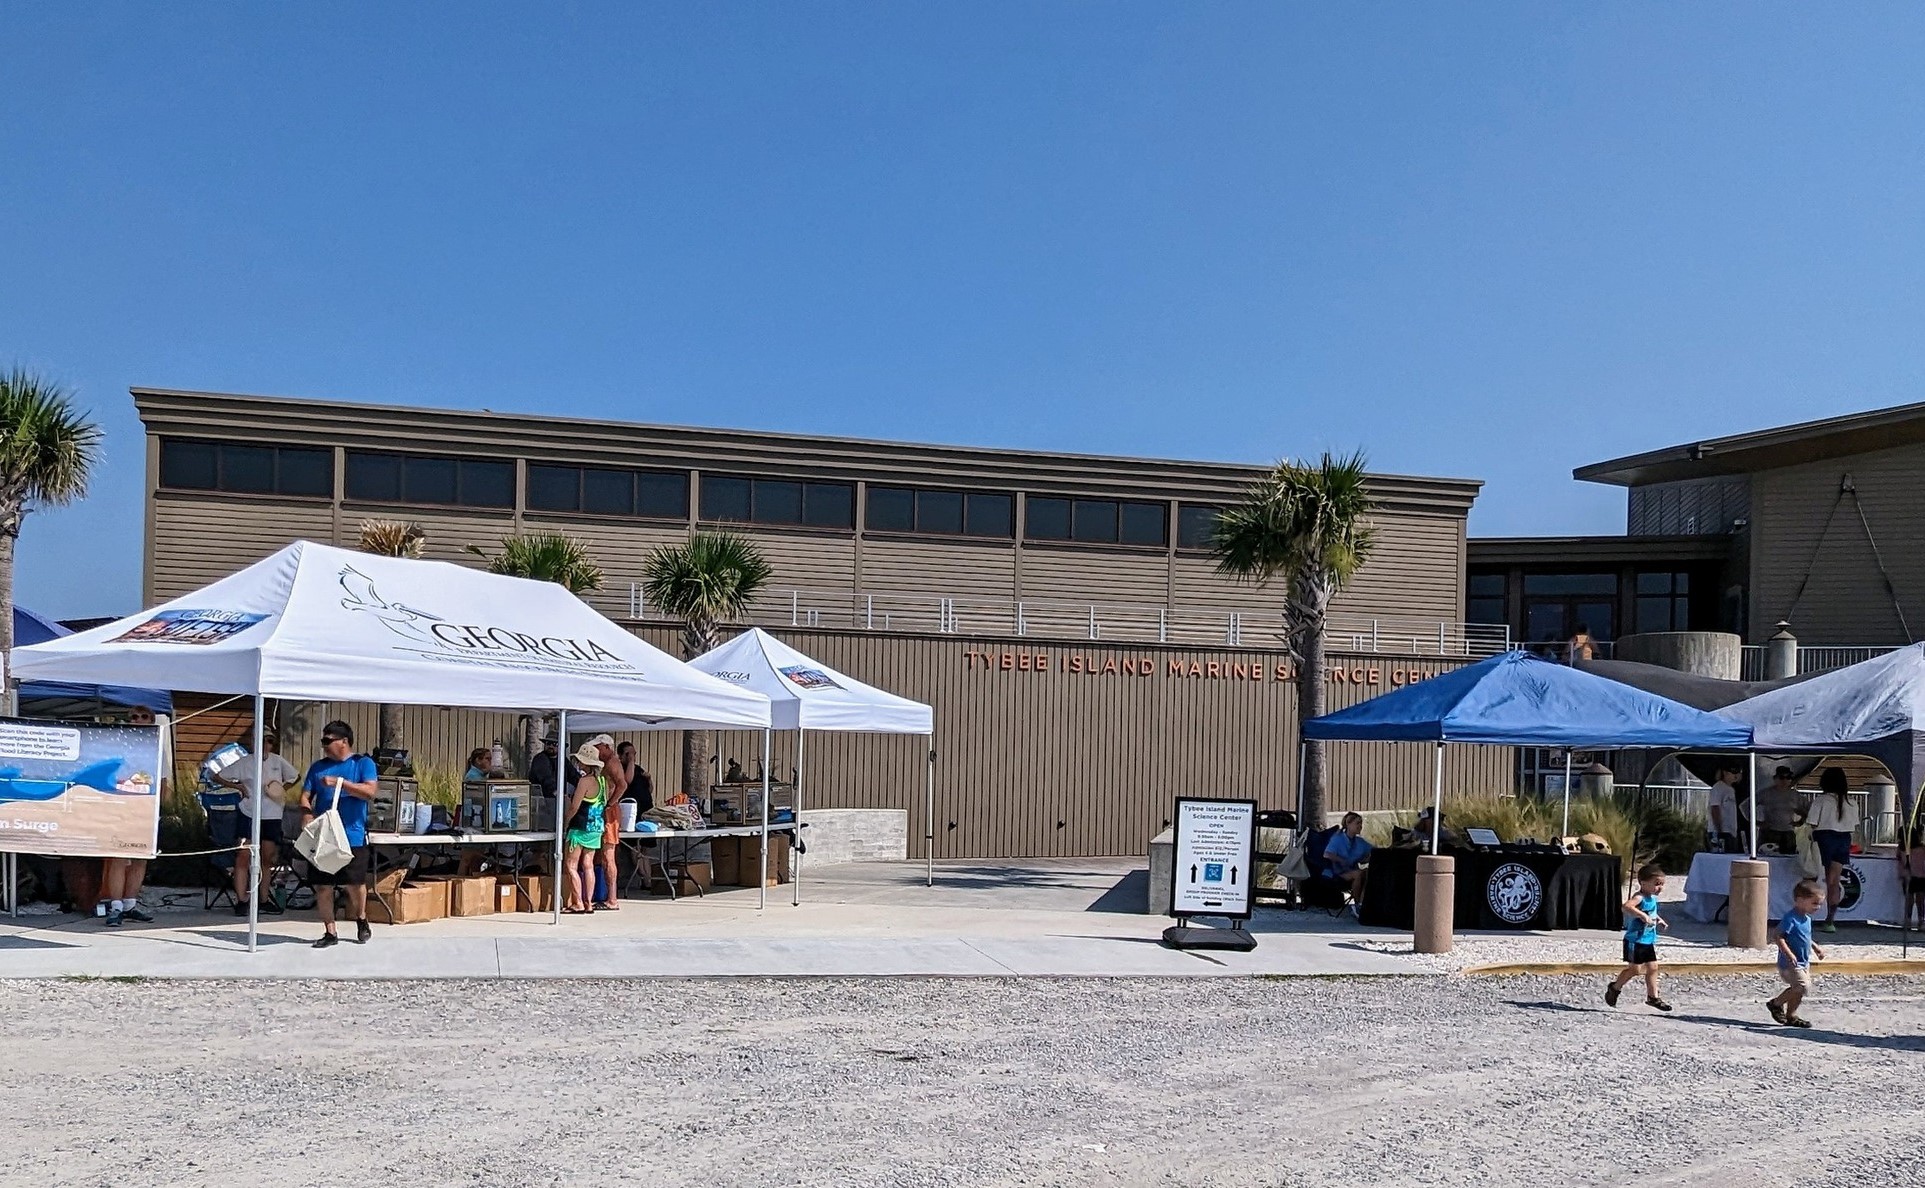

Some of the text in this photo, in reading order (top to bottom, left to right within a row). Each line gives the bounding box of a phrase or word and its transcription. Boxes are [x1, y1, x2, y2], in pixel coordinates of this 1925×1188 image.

[431, 623, 625, 661] GEORGIA
[966, 650, 1048, 671] TYBEE
[1061, 655, 1154, 676] ISLAND
[1168, 659, 1263, 680] MARINE
[1276, 664, 1380, 683] SNCE
[14, 819, 58, 832] Surge
[1492, 866, 1536, 884] TYBEE ISLAND
[1851, 863, 1866, 884] LAND
